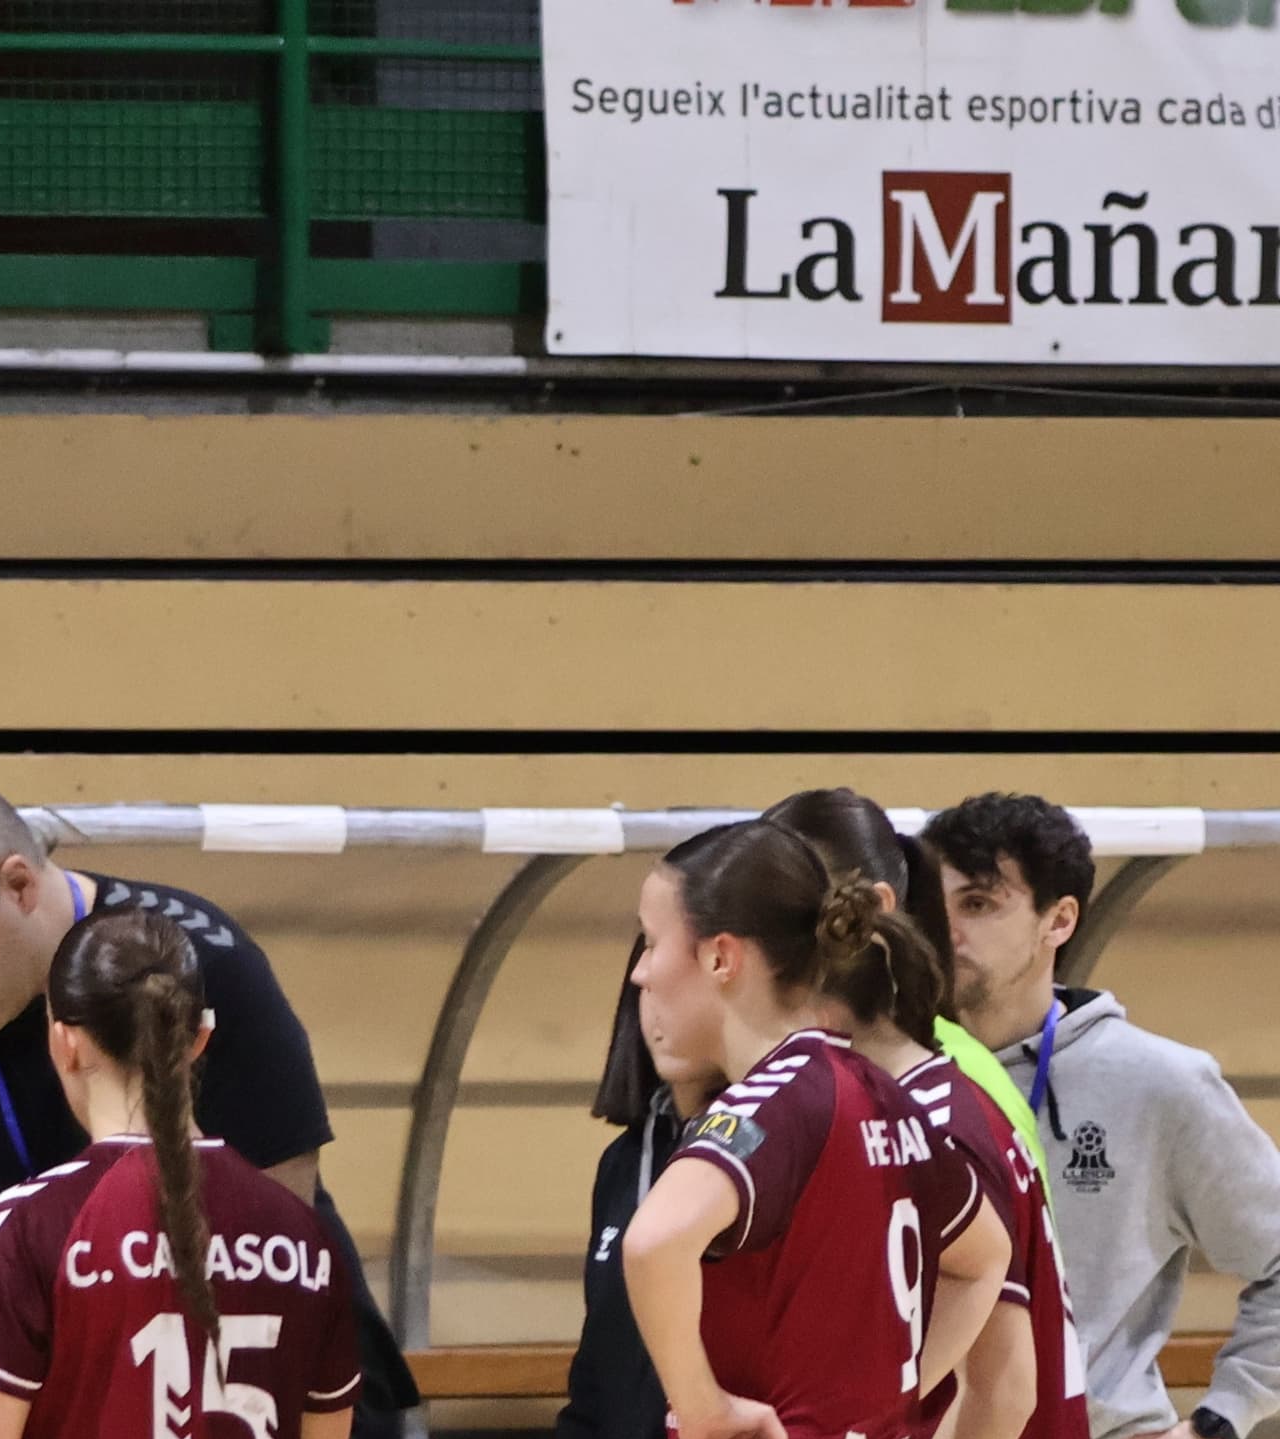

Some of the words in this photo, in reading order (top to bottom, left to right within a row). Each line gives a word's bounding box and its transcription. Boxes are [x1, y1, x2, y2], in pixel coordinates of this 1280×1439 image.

[572, 79, 725, 123] Segueix
[741, 83, 952, 122] l'actualitat
[967, 89, 1142, 130] esportiva
[1158, 92, 1246, 126] cada
[715, 188, 863, 302] La
[65, 1240, 114, 1288] C.
[121, 1230, 332, 1292] CAASOLA
